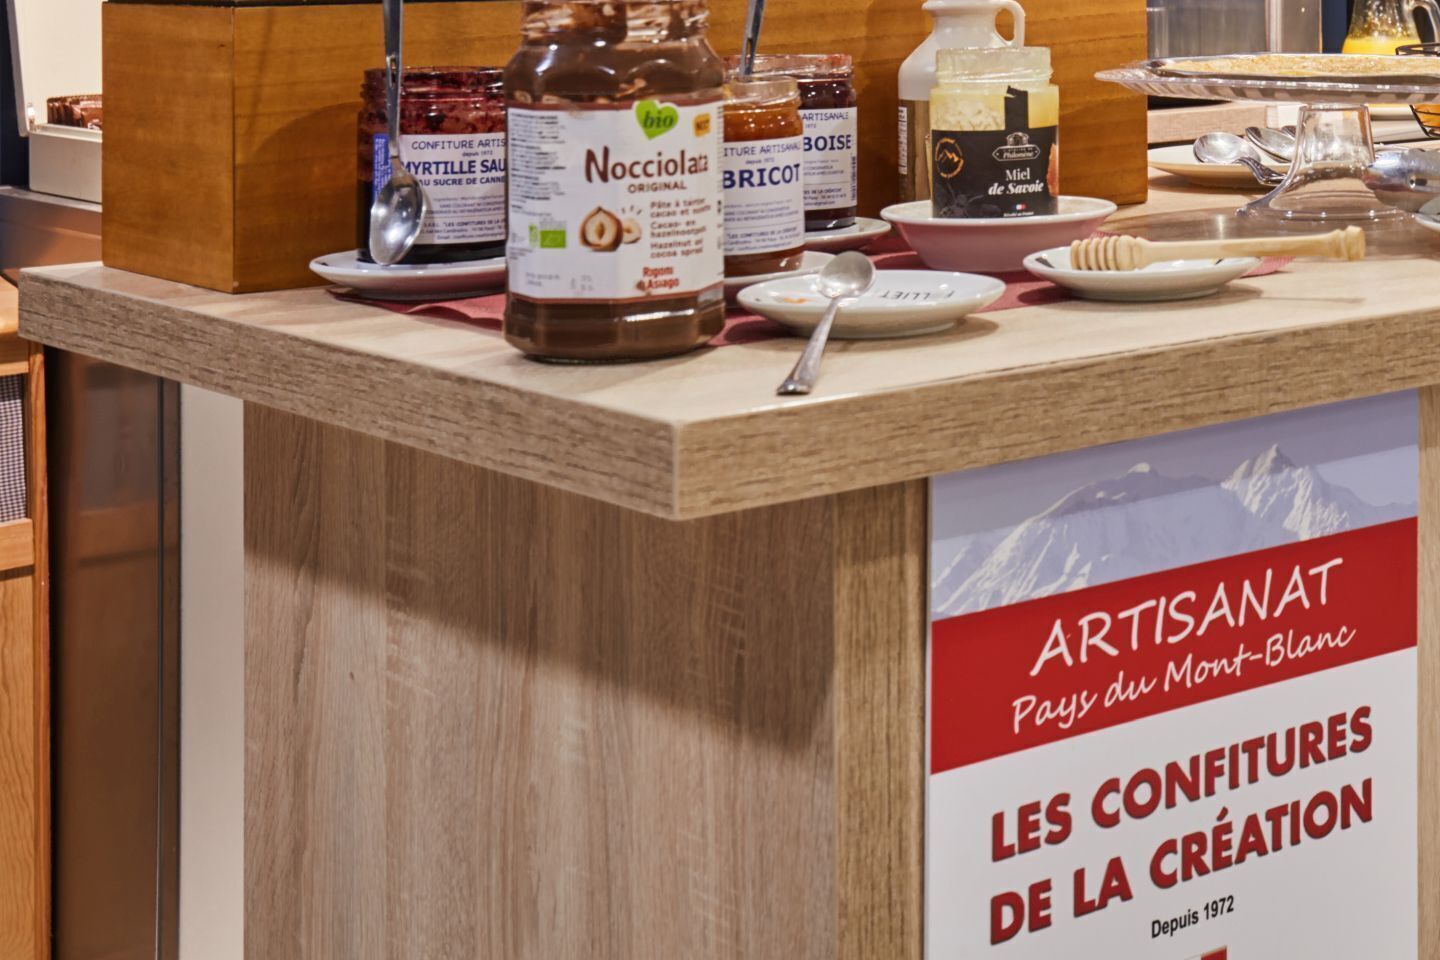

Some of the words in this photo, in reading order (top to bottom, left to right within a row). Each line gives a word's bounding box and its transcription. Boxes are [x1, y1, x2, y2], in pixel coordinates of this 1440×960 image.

[642, 109, 674, 129] bio
[411, 140, 474, 151] CONFITURE
[477, 138, 507, 148] ARTIS
[723, 146, 757, 157] ITURE
[803, 134, 852, 152] BOISE
[433, 178, 463, 186] SUCRE
[465, 177, 477, 185] DE
[722, 163, 801, 189] BRICOT
[1005, 167, 1031, 181] Miel
[627, 181, 688, 194] ORIGINAL
[987, 183, 1005, 195] de
[1006, 180, 1045, 195] Savoie
[879, 290, 955, 300] FLLIET
[1029, 557, 1344, 677] ARTISANAT
[1011, 691, 1097, 735] Pays
[1103, 671, 1158, 710] du
[1162, 624, 1357, 694] Mont-Blanc
[990, 792, 1074, 863] LES
[1090, 705, 1374, 829] CONFITURES
[989, 878, 1053, 947] DE
[1072, 855, 1134, 920] LA
[1148, 777, 1374, 891] CRÉATION
[1150, 908, 1200, 939] Depuis
[1202, 894, 1236, 923] 1972
